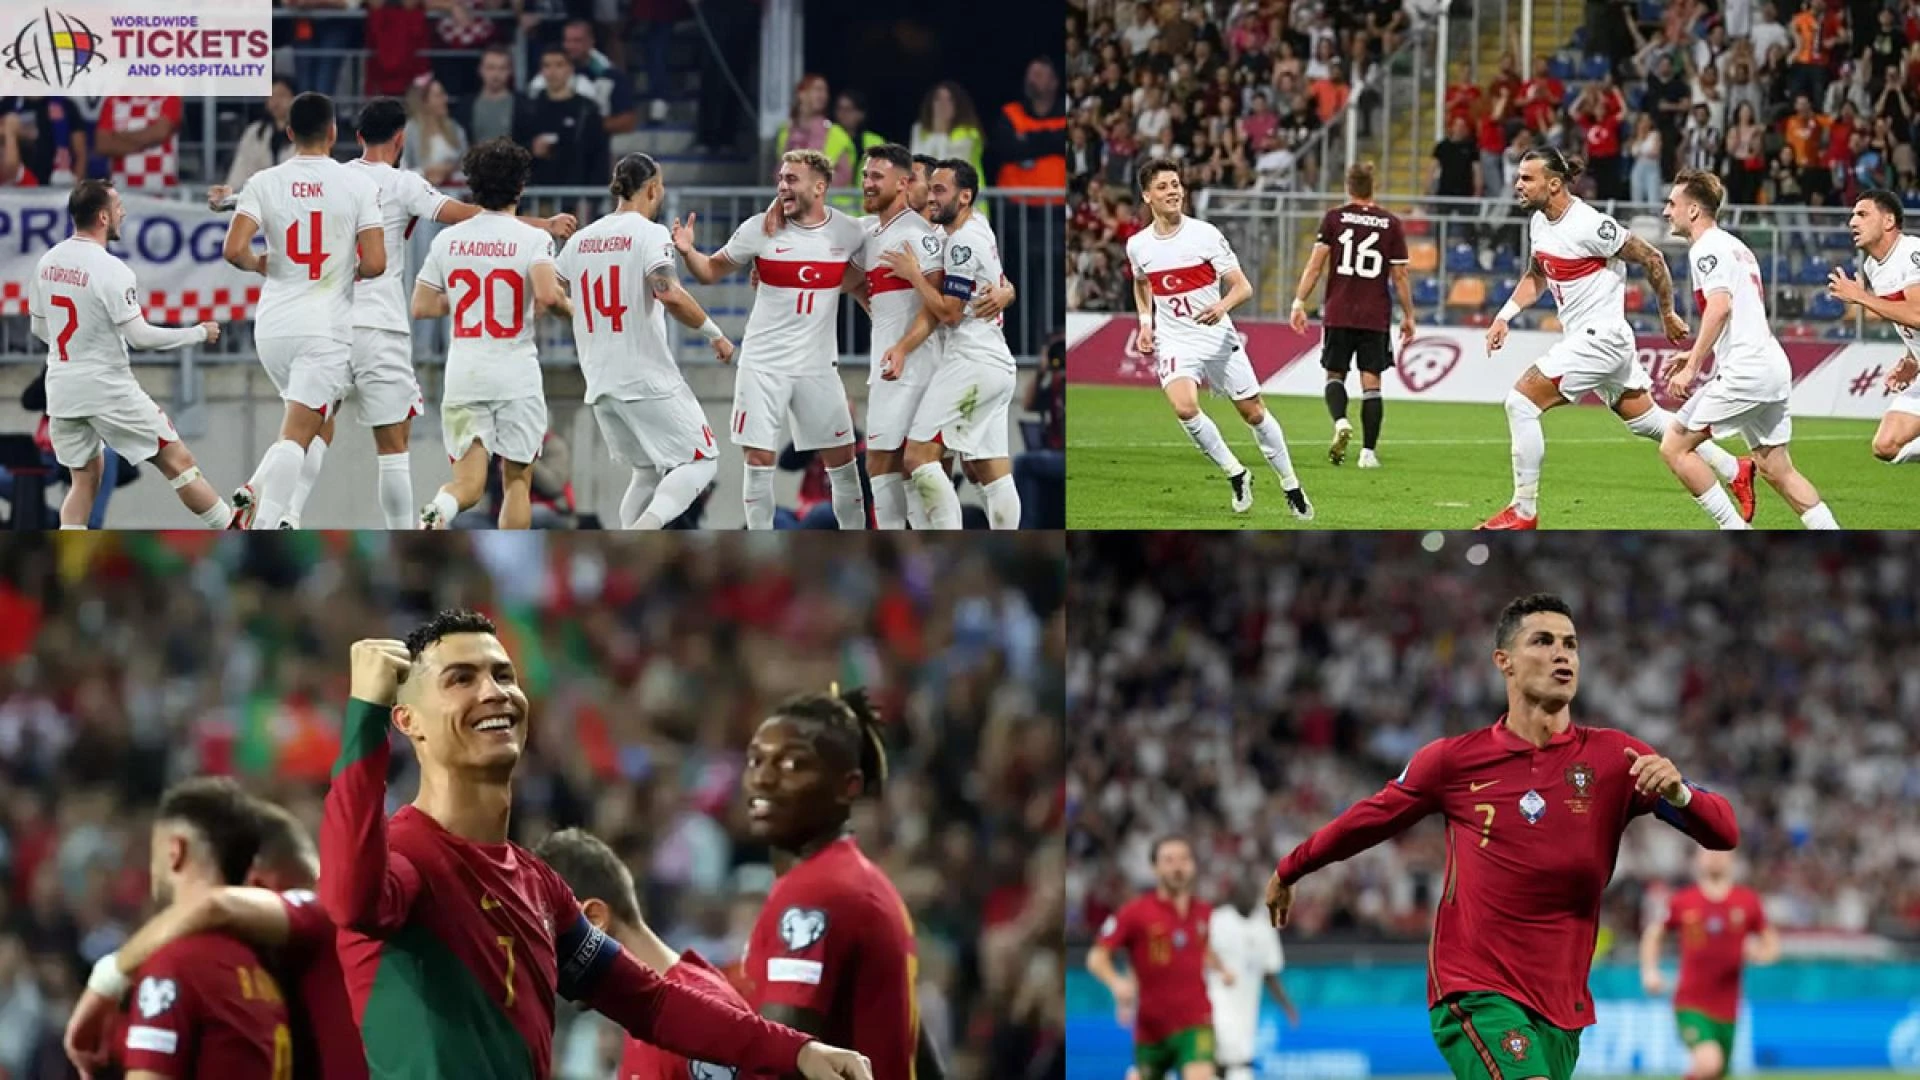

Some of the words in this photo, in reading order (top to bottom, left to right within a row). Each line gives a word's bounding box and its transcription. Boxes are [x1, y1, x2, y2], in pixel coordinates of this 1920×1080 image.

[291, 182, 323, 198] CENK
[286, 210, 330, 279] 4
[1336, 228, 1384, 279] 16
[50, 294, 78, 361] 7
[448, 269, 524, 339] 20
[580, 265, 628, 334] 14
[796, 291, 814, 315] 11
[1168, 296, 1193, 318] 21
[1474, 804, 1496, 848] 7
[496, 935, 516, 1008] 7
